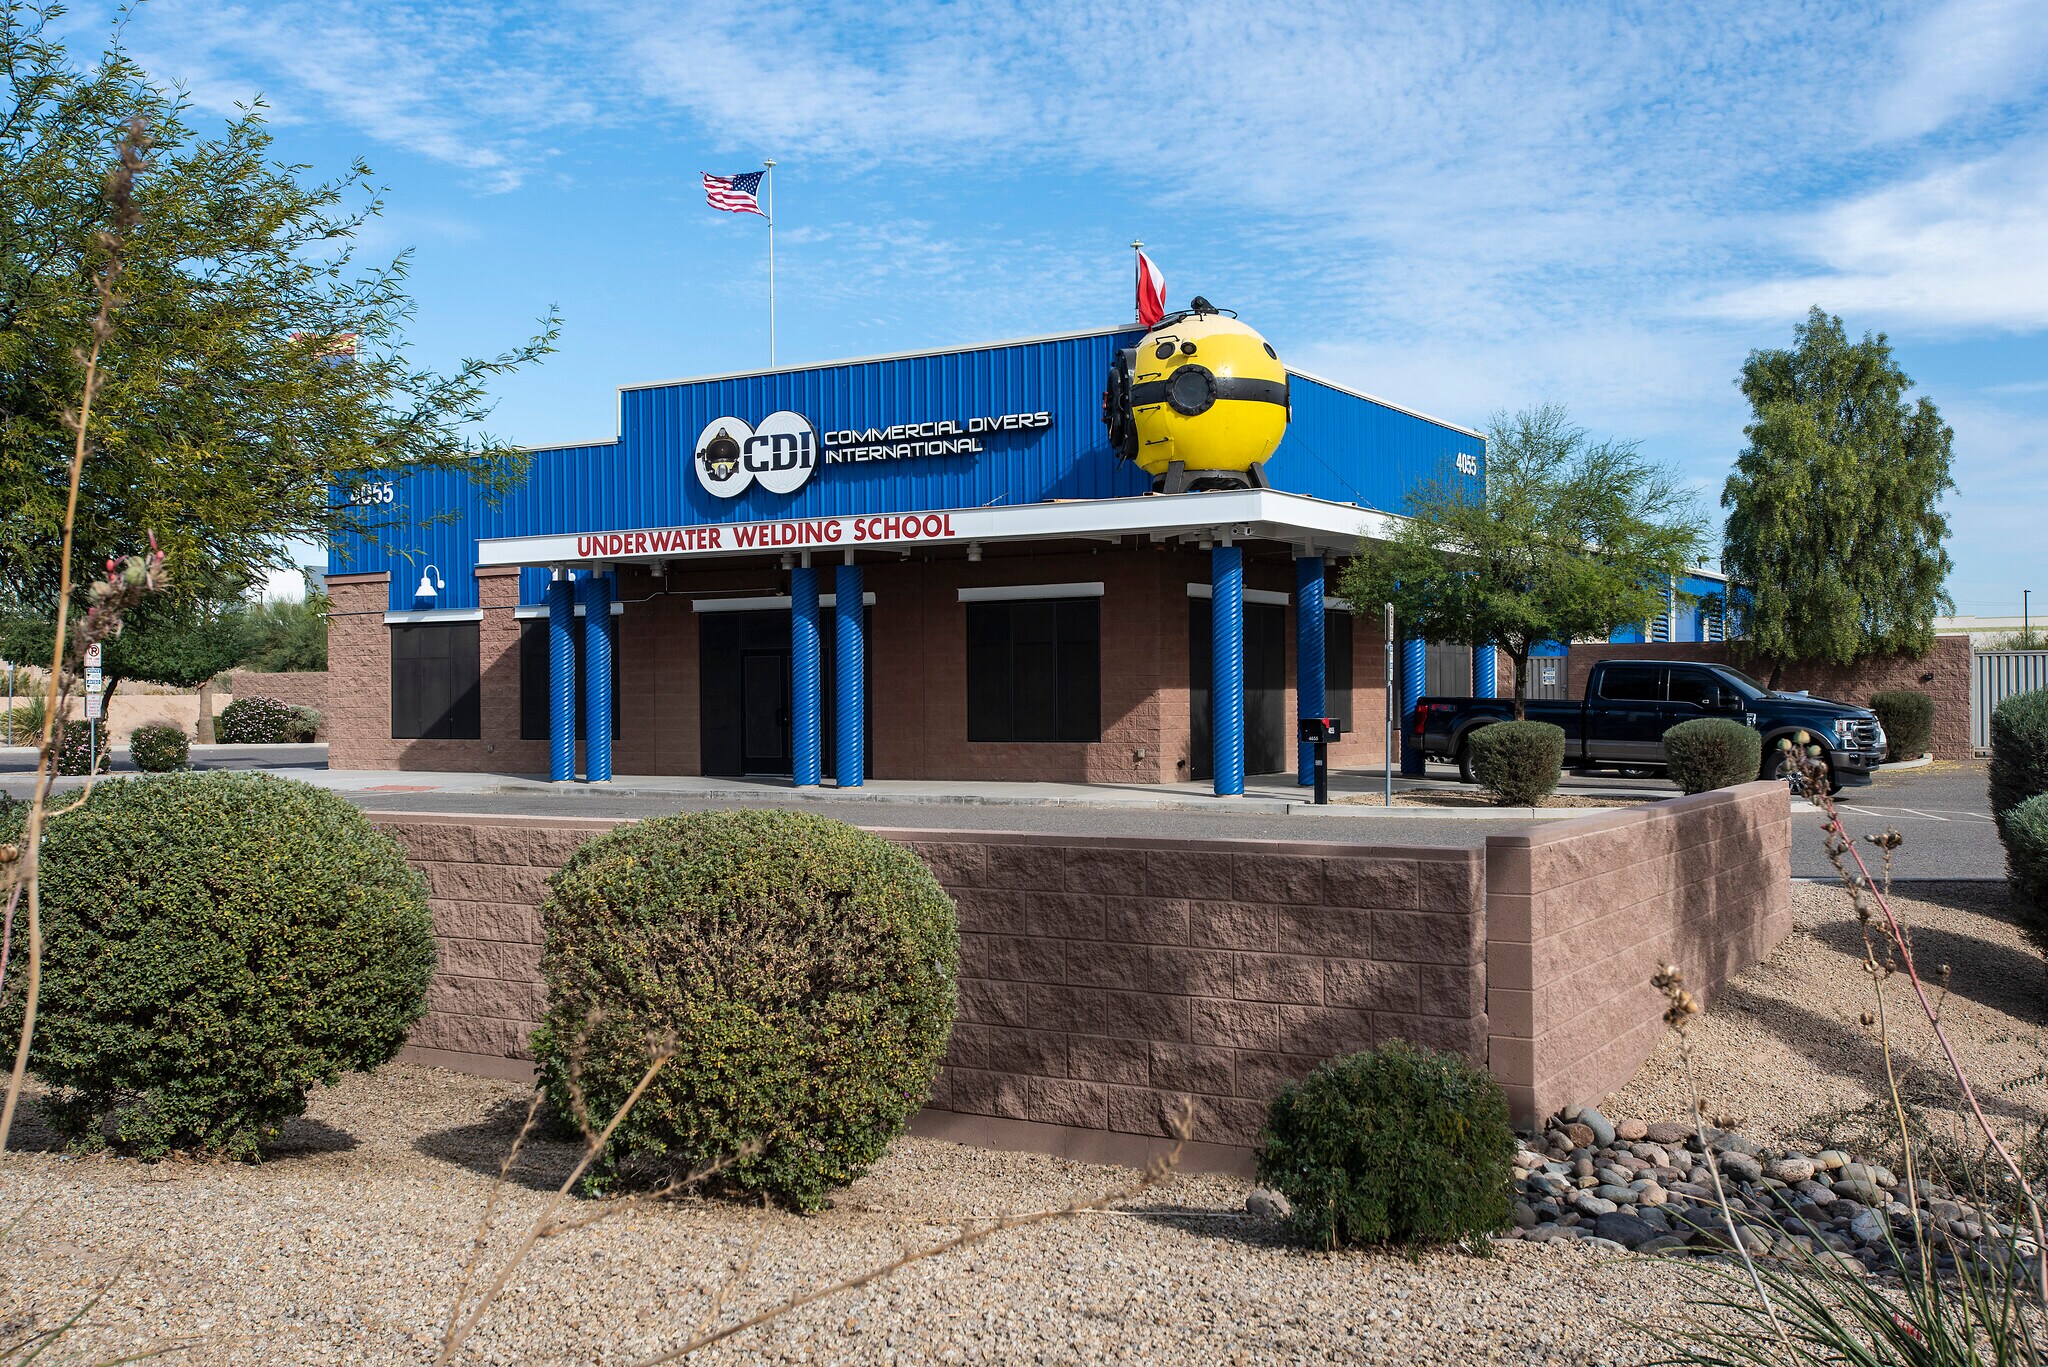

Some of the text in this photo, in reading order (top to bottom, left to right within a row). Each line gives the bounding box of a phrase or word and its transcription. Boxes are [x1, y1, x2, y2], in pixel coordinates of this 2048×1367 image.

[824, 411, 1049, 446] COMMERCIAL DIVERS
[743, 431, 812, 472] CDI
[825, 437, 983, 464] INTERNATIONAL
[1456, 452, 1477, 476] 4055
[577, 514, 956, 557] UNDERWATER WELDING SCHOOL
